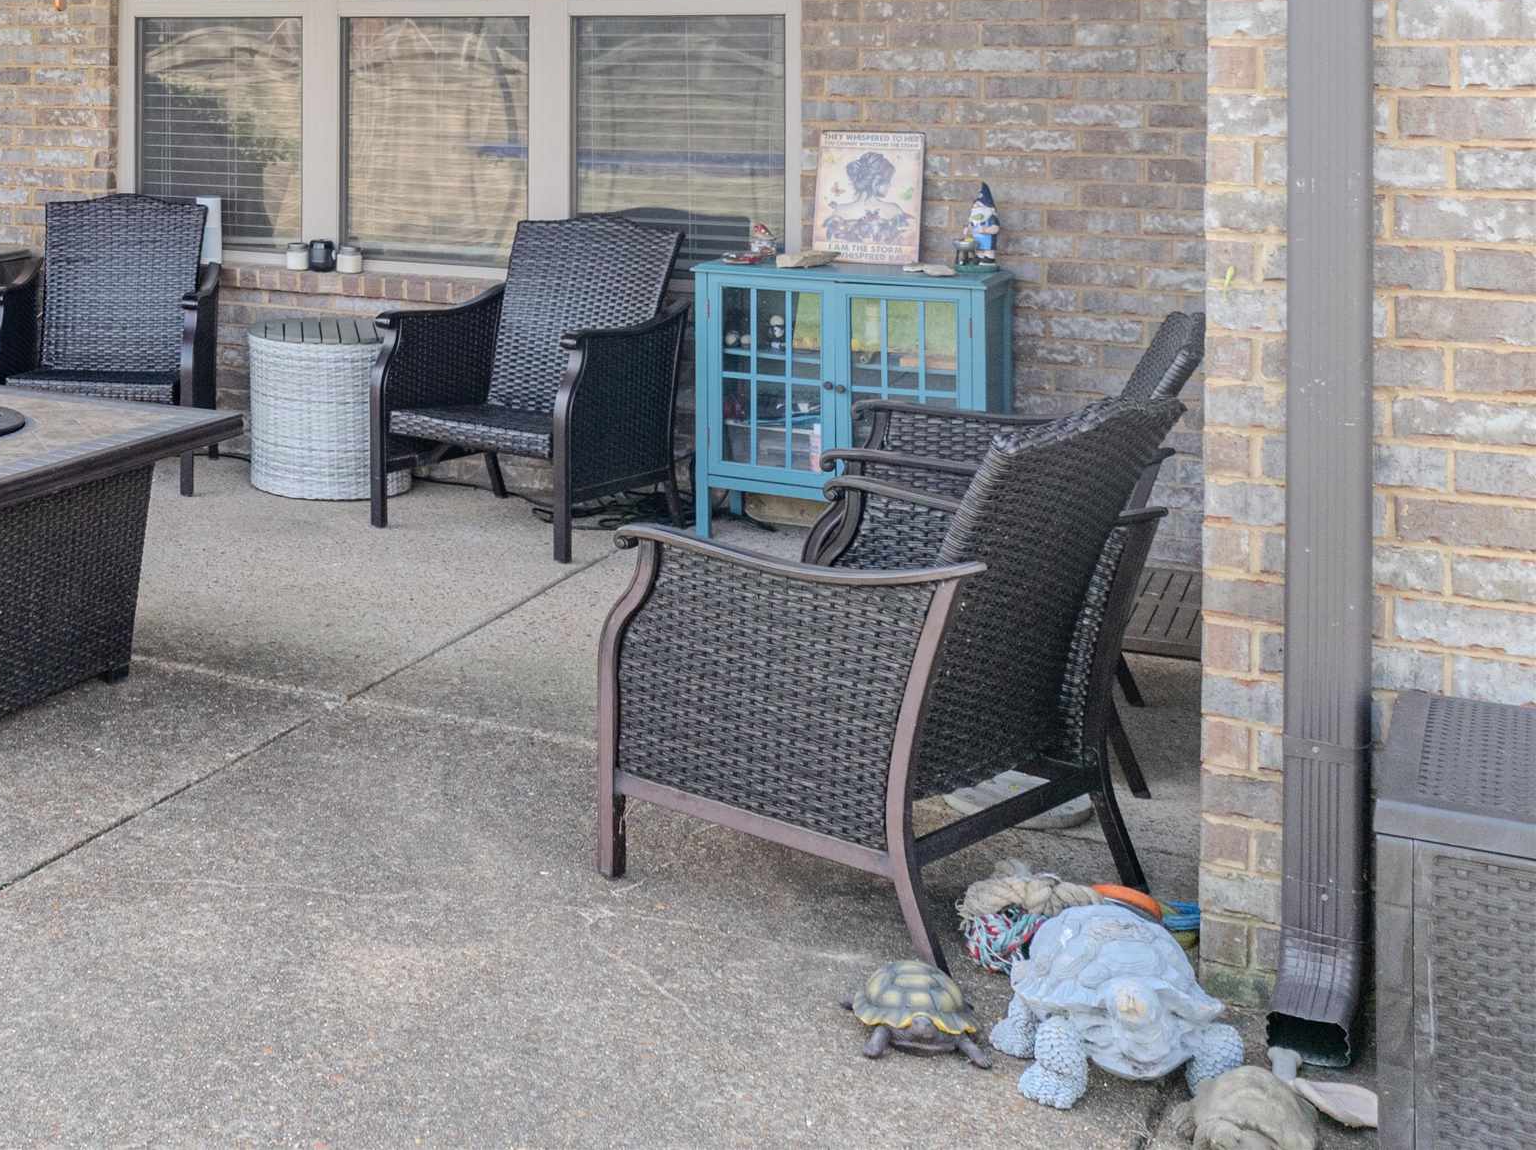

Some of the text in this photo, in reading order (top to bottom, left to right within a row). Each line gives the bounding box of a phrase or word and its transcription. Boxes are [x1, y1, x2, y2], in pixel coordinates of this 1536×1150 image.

[824, 132, 843, 140] THEY
[847, 133, 890, 142] WHISPERED
[834, 243, 849, 251] AM
[851, 244, 869, 252] THE
[870, 245, 904, 254] STORM
